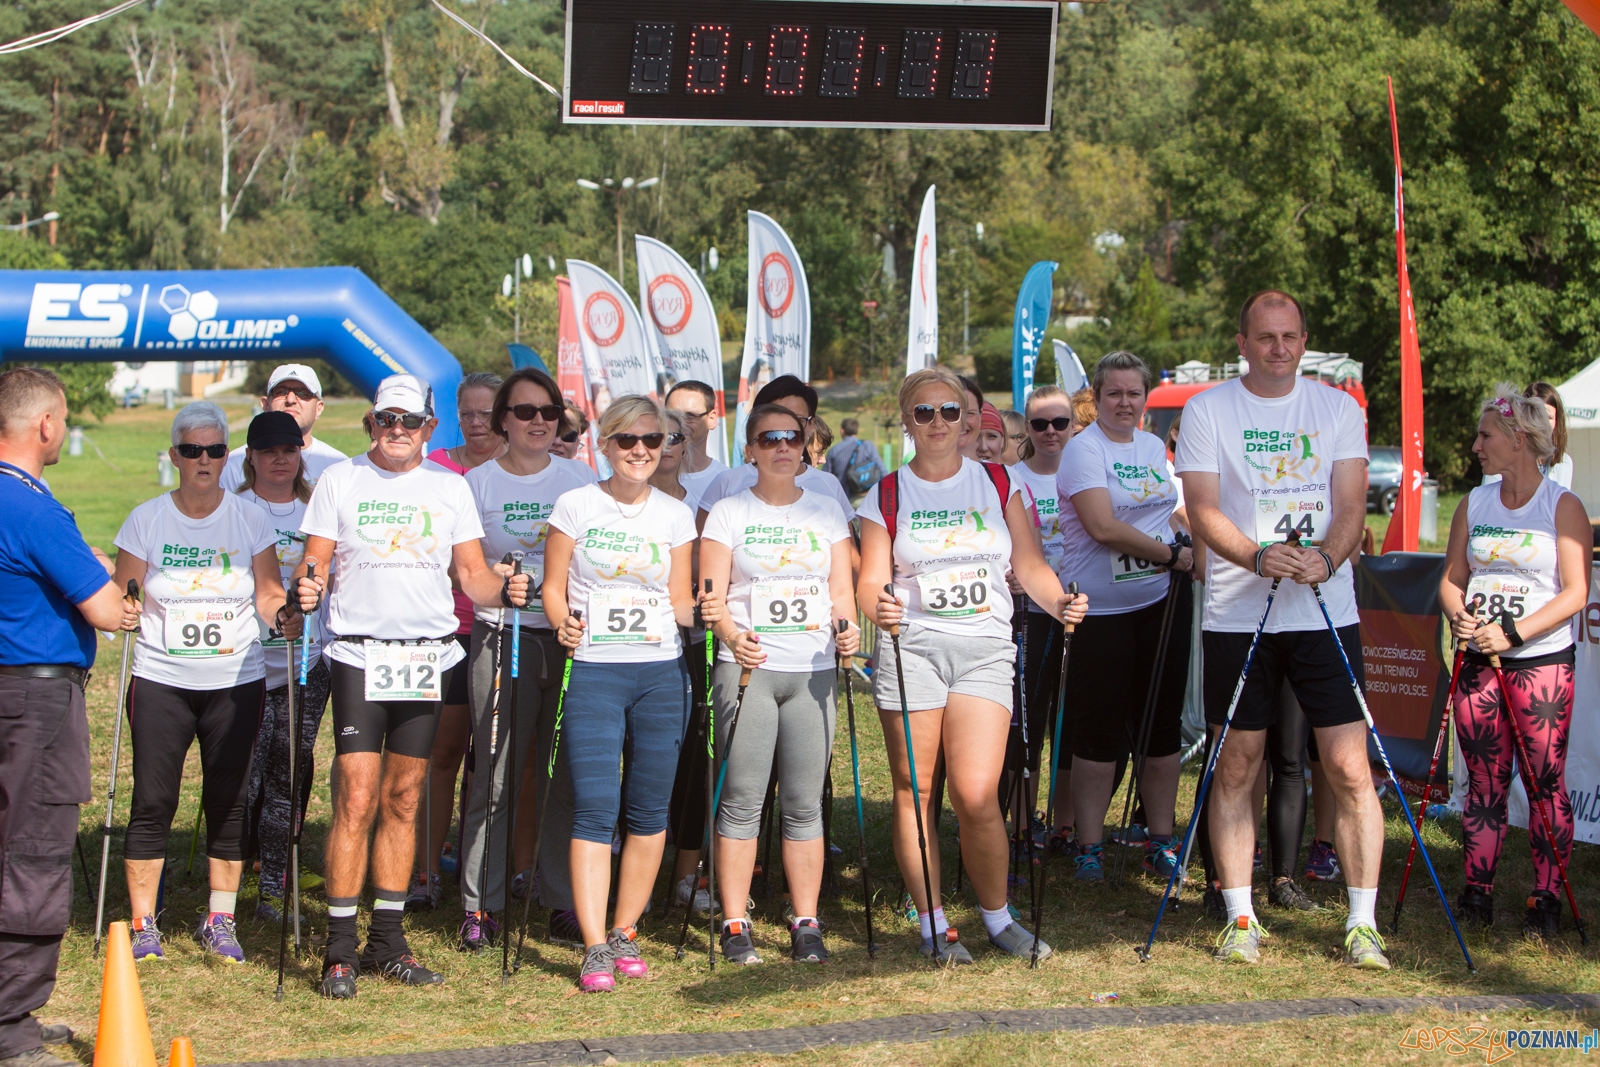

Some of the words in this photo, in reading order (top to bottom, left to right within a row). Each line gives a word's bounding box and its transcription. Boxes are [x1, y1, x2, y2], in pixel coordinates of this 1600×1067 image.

[24, 337, 88, 348] ENDURANCE
[89, 337, 124, 349] SPORT
[146, 341, 194, 349] SPORT
[199, 340, 281, 349] NUTRITION
[1243, 428, 1280, 442] Bieg
[1245, 440, 1292, 453] Dzieci
[357, 500, 399, 513] Bieg
[401, 504, 418, 512] dla
[503, 501, 540, 513] Bieg
[1034, 498, 1055, 507] ieg
[358, 513, 413, 526] Dzieci
[911, 509, 948, 520] Bieg
[744, 524, 784, 536] Bieg
[911, 516, 963, 531] Dzieci
[1273, 513, 1315, 538] 44
[587, 527, 627, 543] Bieg
[629, 535, 645, 543] dla
[745, 535, 798, 545] Dzieci
[162, 543, 200, 559] Bieg
[201, 548, 216, 556] dla
[584, 539, 640, 553] Dzieci
[161, 556, 213, 567] Dzieci
[358, 562, 370, 570] 17
[911, 560, 922, 569] 17
[973, 553, 1002, 562] 2016
[928, 581, 987, 609] 330
[769, 599, 808, 624] 93
[1472, 592, 1525, 619] 285
[607, 608, 647, 633] 52
[181, 623, 222, 648] 96
[373, 664, 435, 690] 312
[1364, 663, 1383, 675] TRUM
[1384, 665, 1419, 678] TRENINGU
[1365, 680, 1389, 693] SKIEGO
[1390, 683, 1399, 694] W
[1399, 683, 1429, 697] POLSCE.
